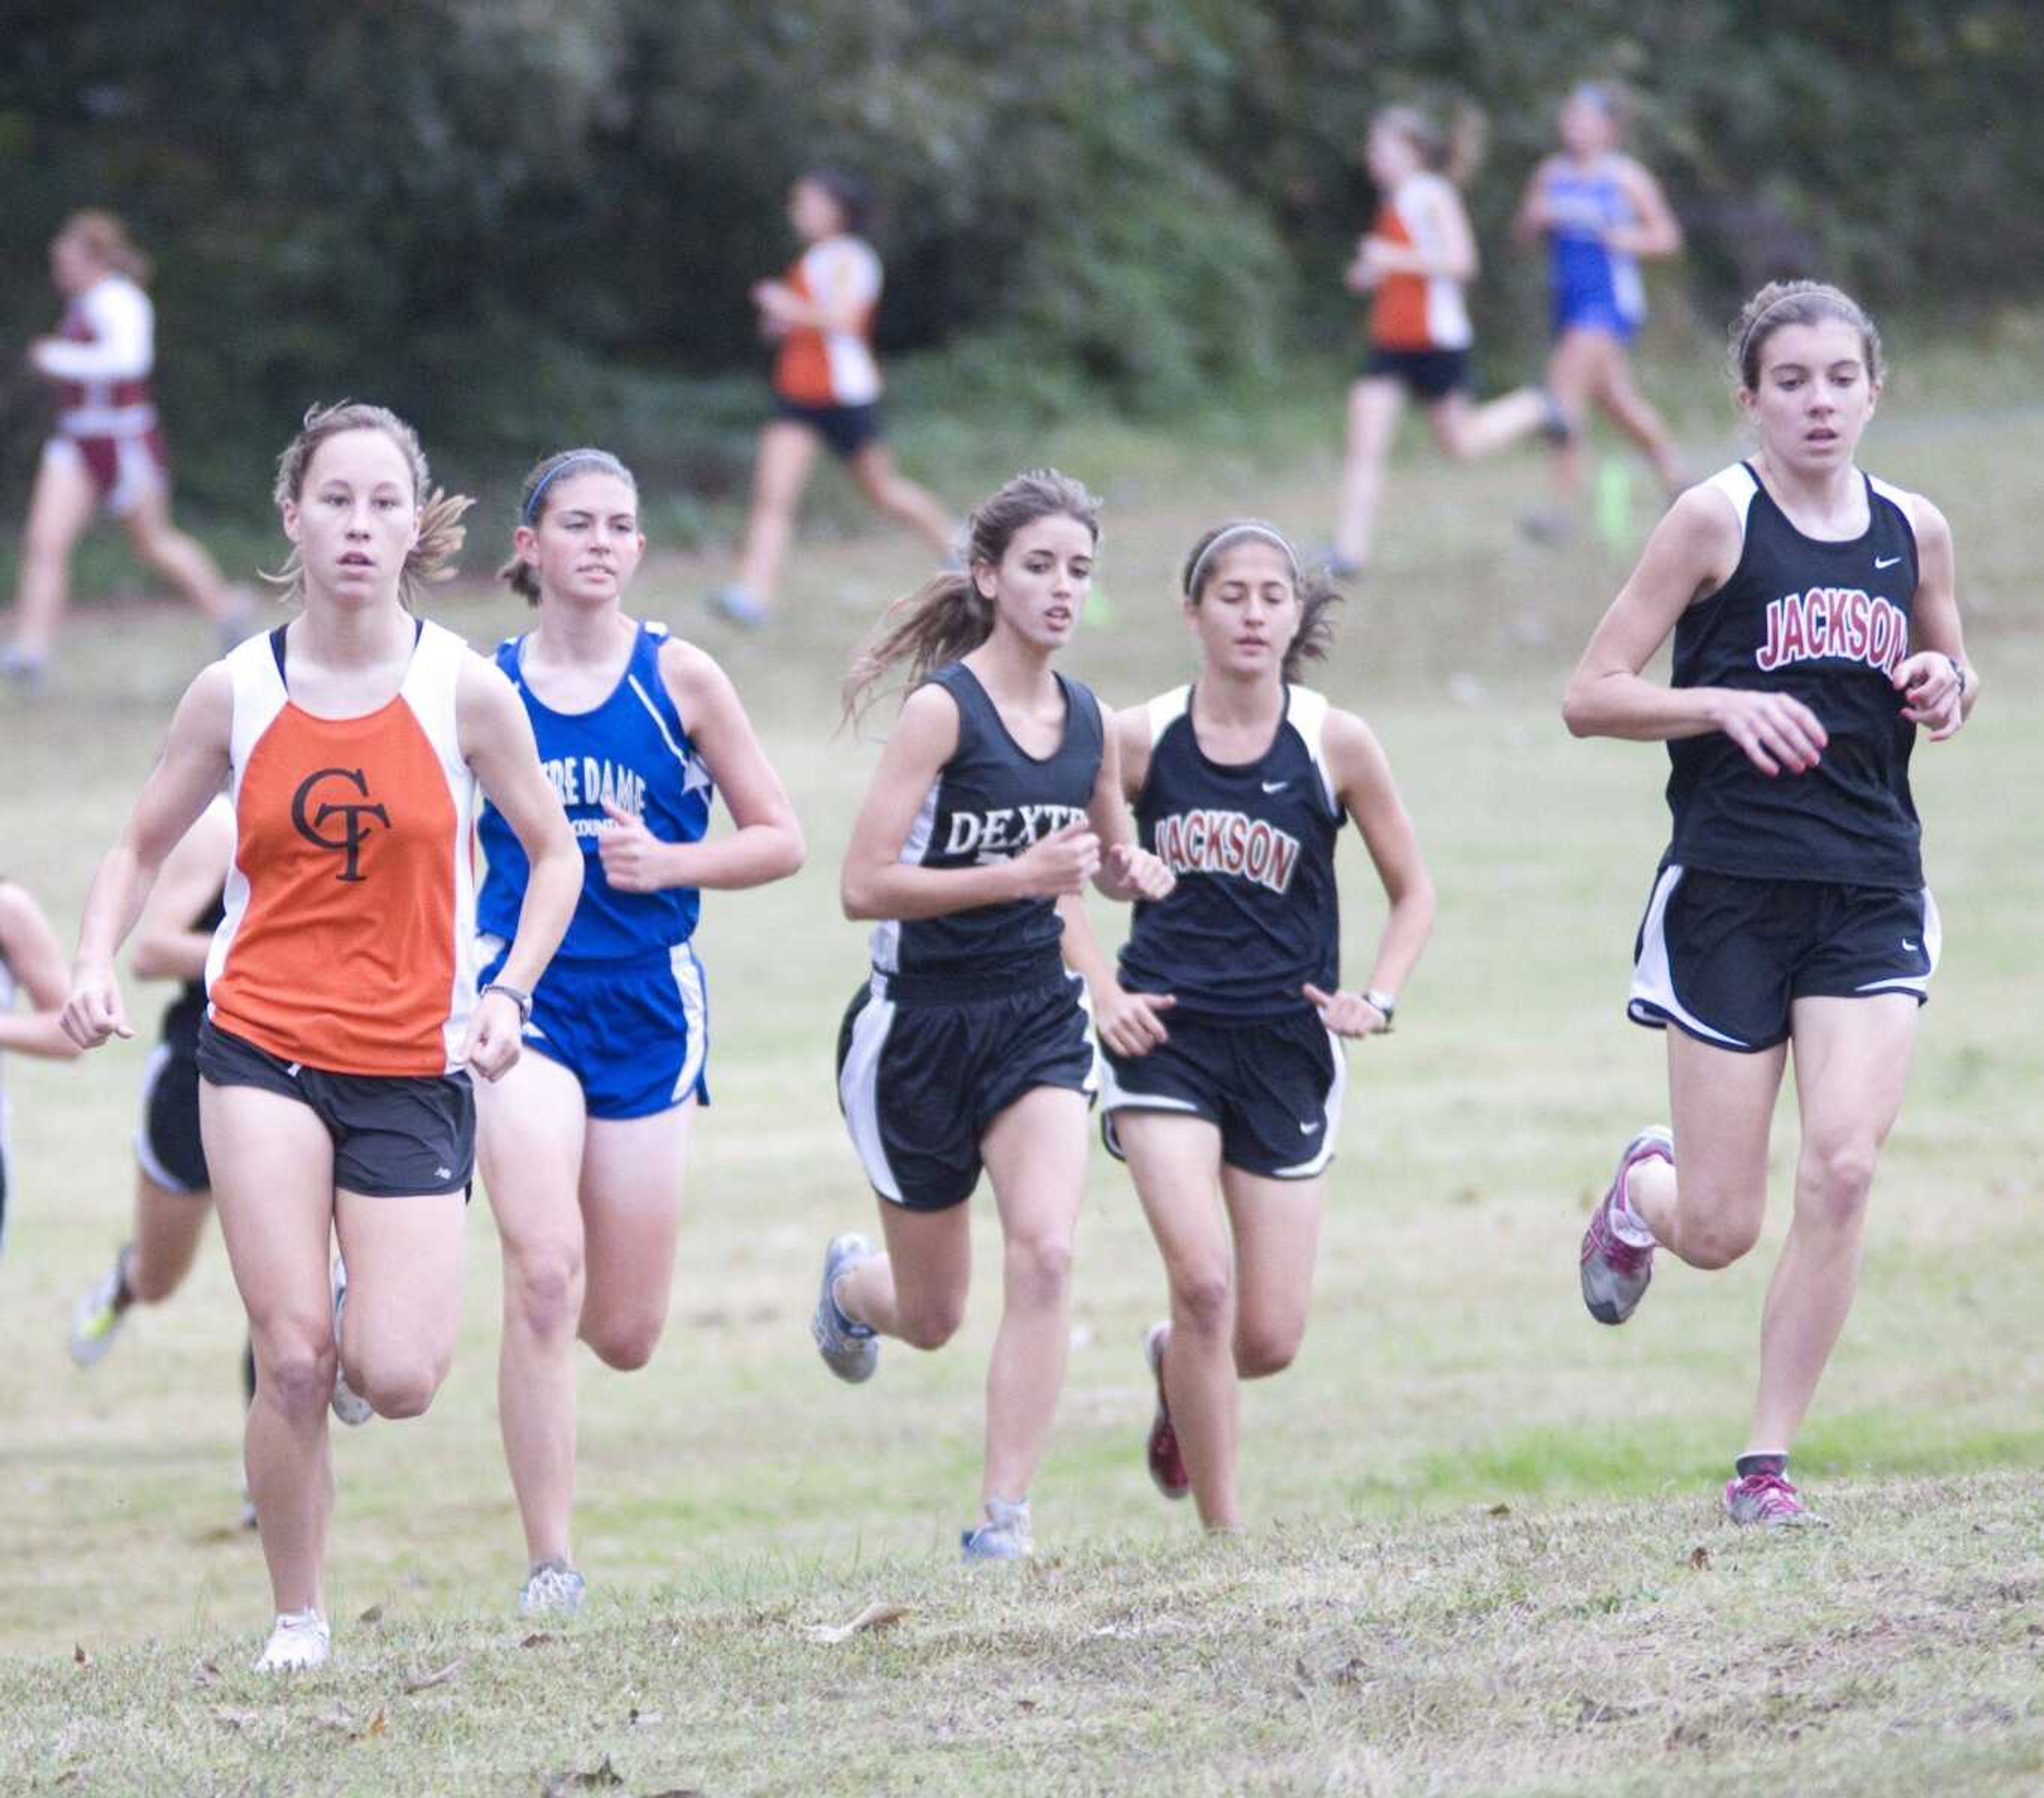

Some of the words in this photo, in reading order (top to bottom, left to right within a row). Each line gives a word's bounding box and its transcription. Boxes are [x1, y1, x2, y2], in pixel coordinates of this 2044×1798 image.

[1757, 587, 1909, 681] JACKSON
[541, 757, 579, 805] RE
[583, 756, 646, 816] DAME
[1155, 809, 1300, 895] JACKSON
